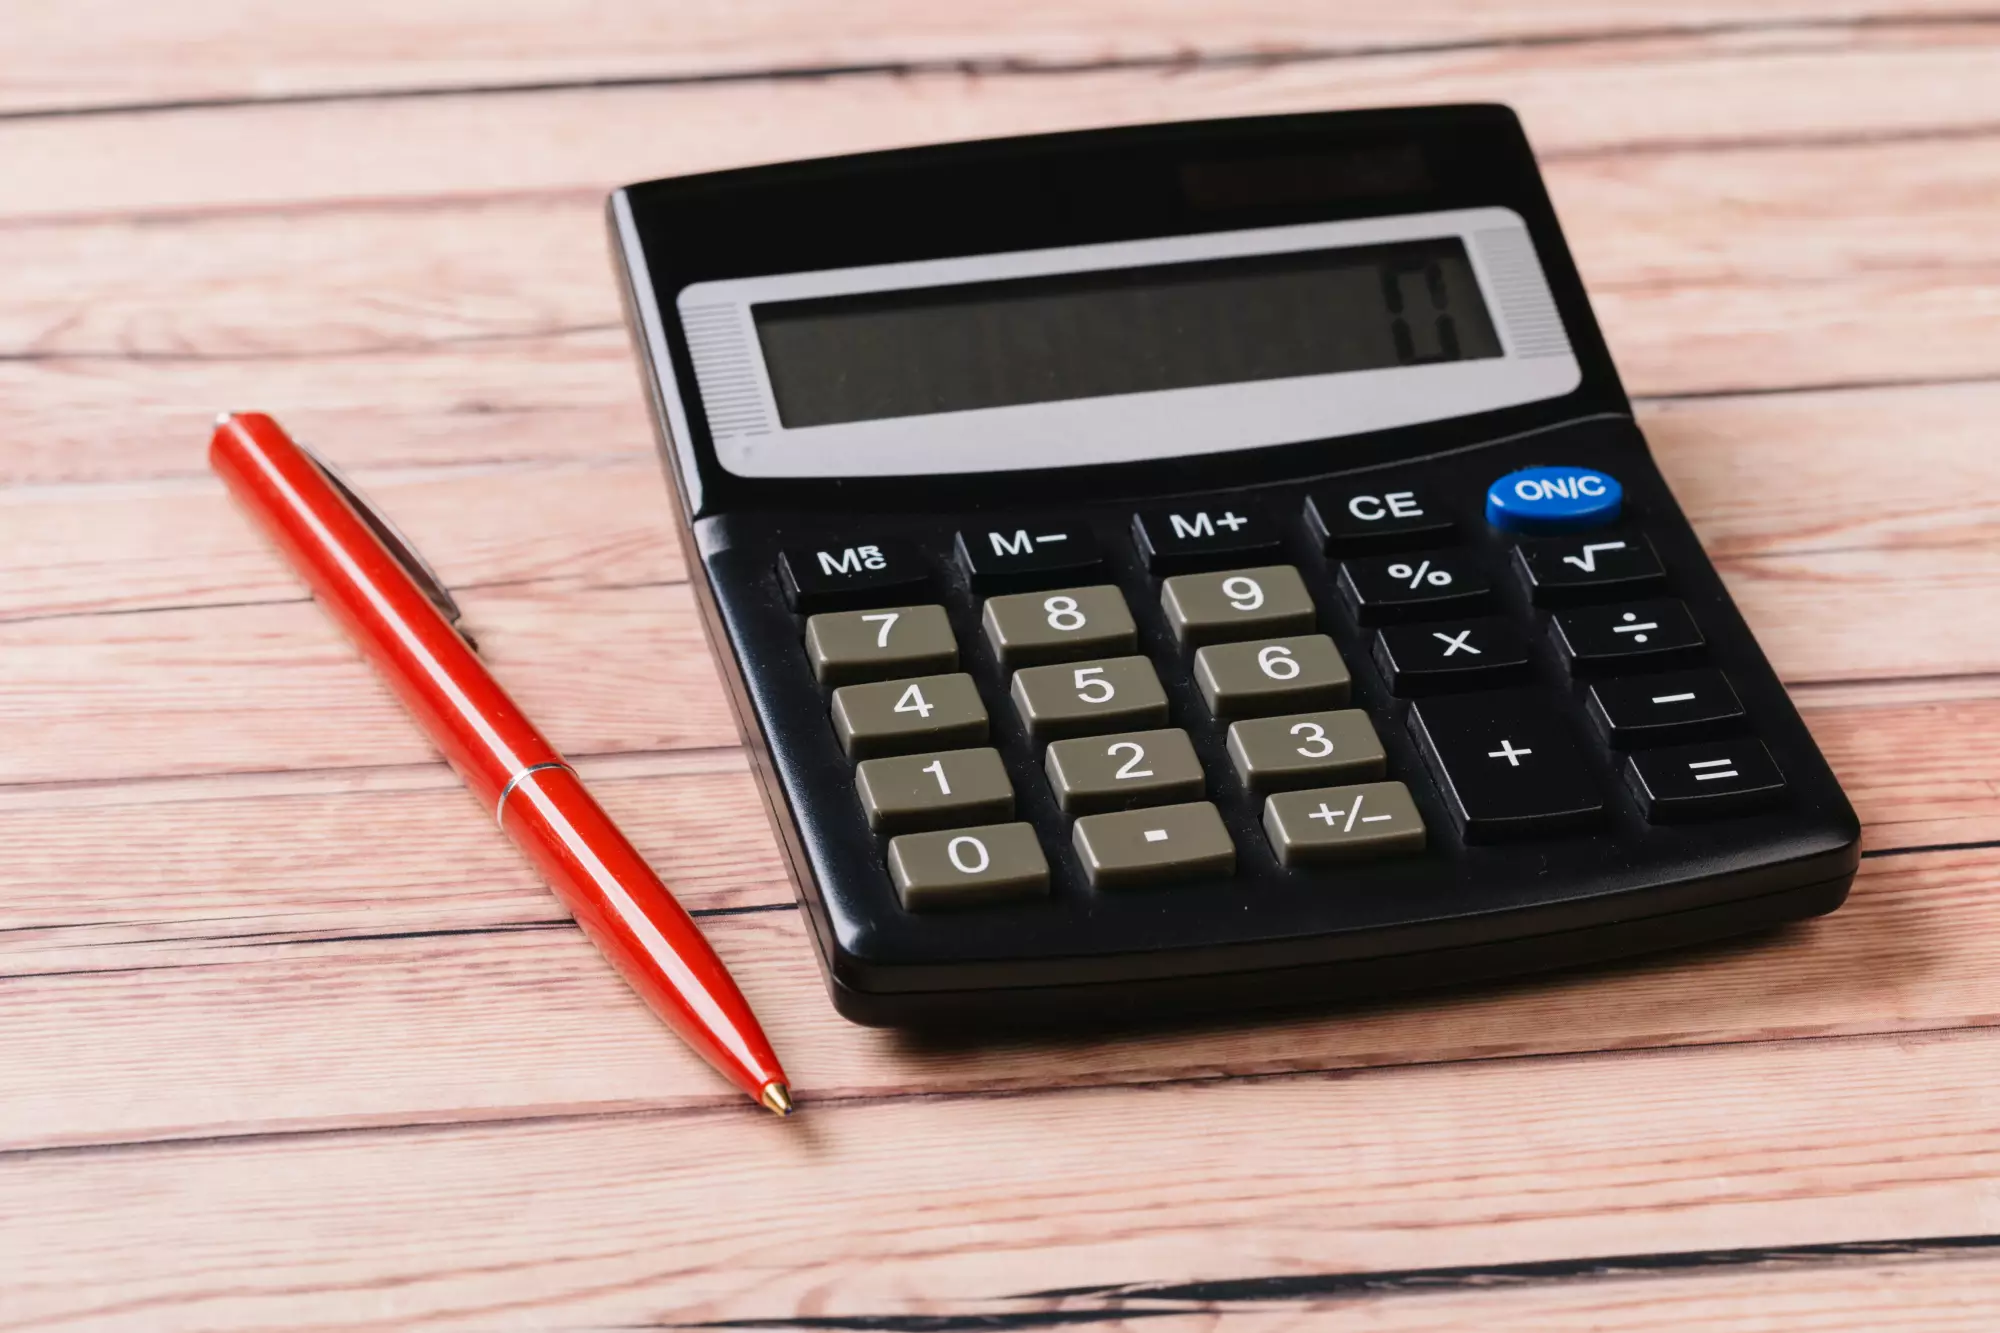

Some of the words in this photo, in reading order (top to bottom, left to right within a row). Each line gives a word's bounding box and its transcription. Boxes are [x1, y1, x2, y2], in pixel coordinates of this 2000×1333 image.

[1381, 259, 1460, 363] 0
[1514, 475, 1606, 501] ON/C
[1348, 491, 1424, 521] CE
[1169, 511, 1248, 539] M+
[988, 529, 1068, 557] M-
[1387, 560, 1453, 589] %
[1222, 576, 1264, 611] 9
[861, 612, 899, 648] 7
[1043, 596, 1086, 631] 8
[1258, 645, 1300, 680] 6
[893, 683, 934, 718] 4
[1074, 667, 1115, 704] 5
[1290, 722, 1334, 758] 3
[1487, 739, 1533, 767] +
[922, 760, 952, 795] 1
[1107, 742, 1154, 780] 2
[1688, 758, 1739, 781] =
[1308, 795, 1392, 833] +/-
[947, 836, 990, 874] 0
